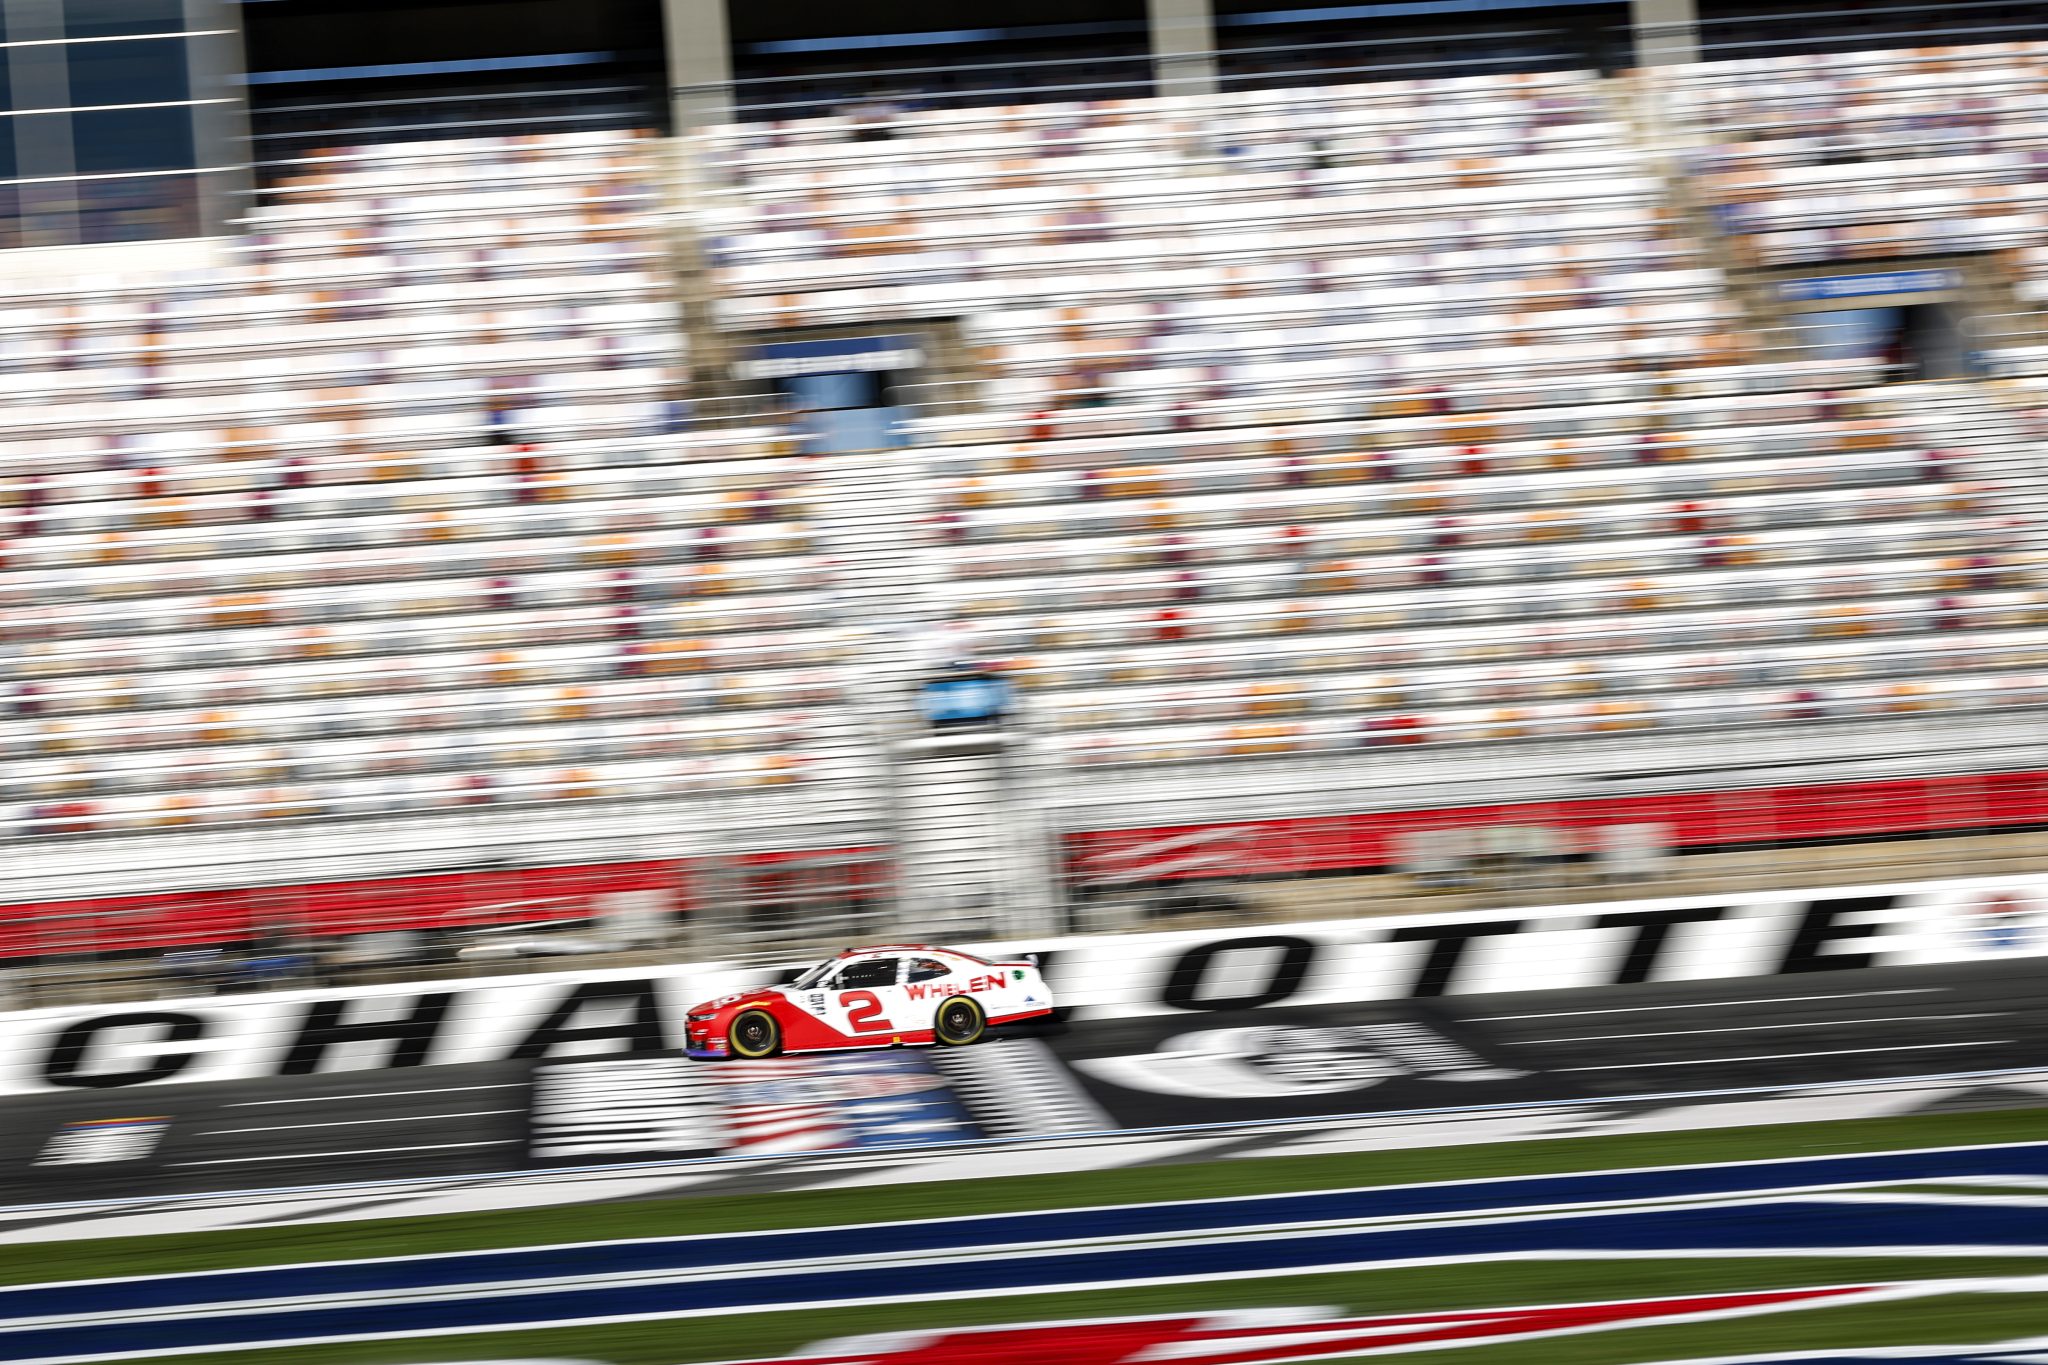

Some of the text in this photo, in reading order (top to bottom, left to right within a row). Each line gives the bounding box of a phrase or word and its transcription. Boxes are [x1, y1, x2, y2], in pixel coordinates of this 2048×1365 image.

[43, 895, 1897, 1088] CHAOTTE
[903, 971, 1007, 1001] WHELEN
[839, 989, 894, 1034] 2
